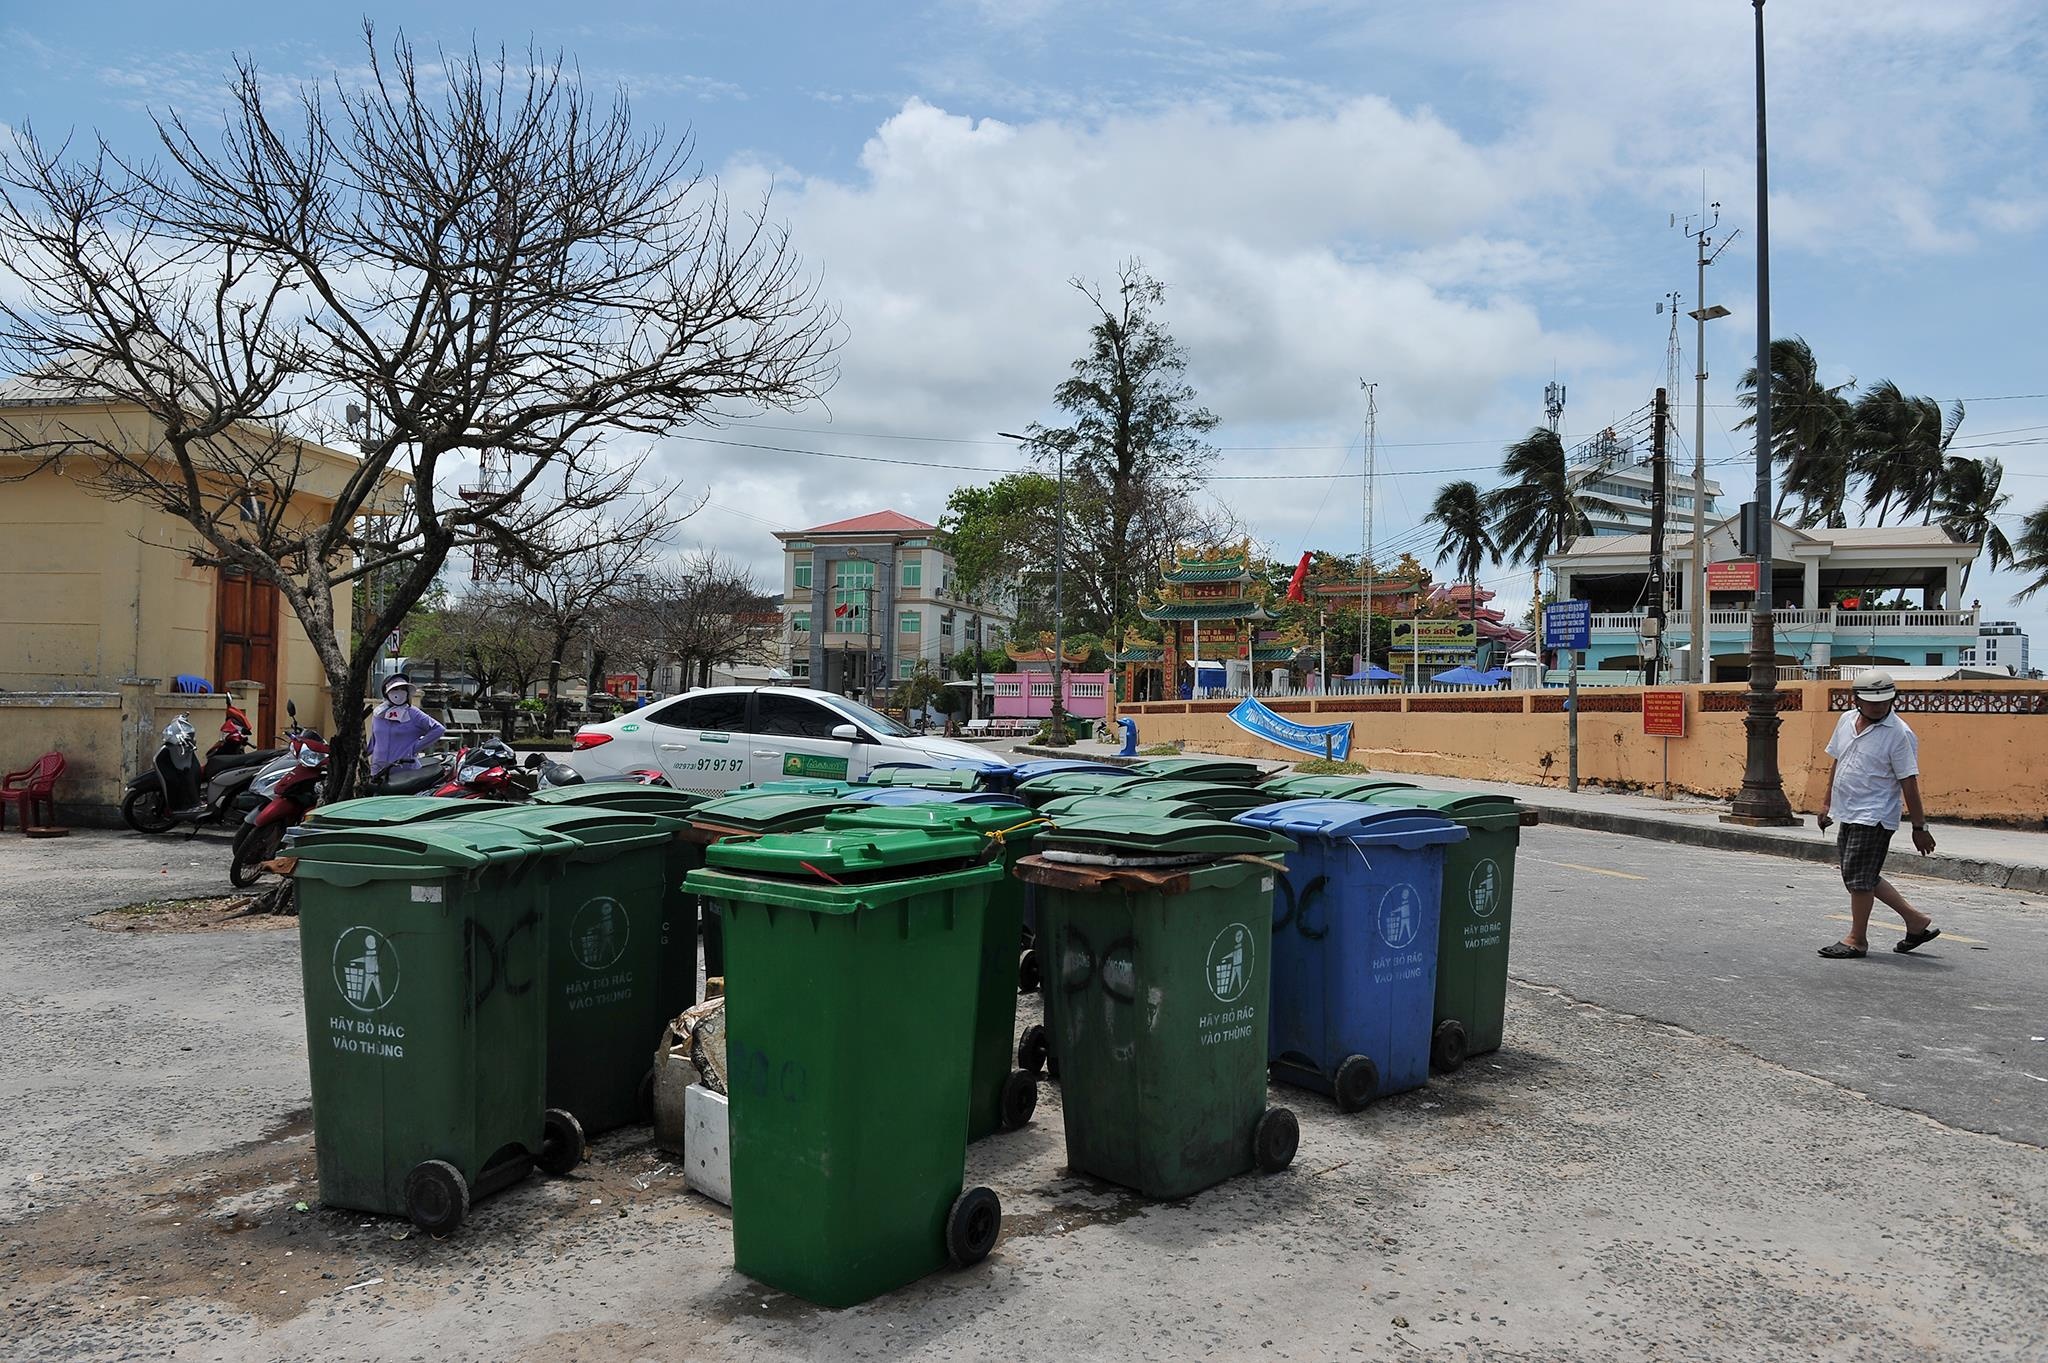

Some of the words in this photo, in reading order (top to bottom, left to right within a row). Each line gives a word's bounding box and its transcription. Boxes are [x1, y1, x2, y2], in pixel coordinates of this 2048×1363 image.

[698, 758, 711, 771] 97
[713, 759, 727, 771] 97
[729, 759, 744, 772] 97
[330, 1015, 354, 1032] HÃY
[357, 1018, 375, 1034] BỎ
[378, 1022, 405, 1038] RÁC
[1200, 1013, 1220, 1028] HÃY
[1222, 1007, 1236, 1024] BỎ
[1237, 1005, 1254, 1021] RÁC
[332, 1035, 358, 1052] VÀO
[359, 1040, 404, 1058] THÙNG
[1201, 1031, 1221, 1046] VÀO
[1223, 1025, 1252, 1041] THÙNG
